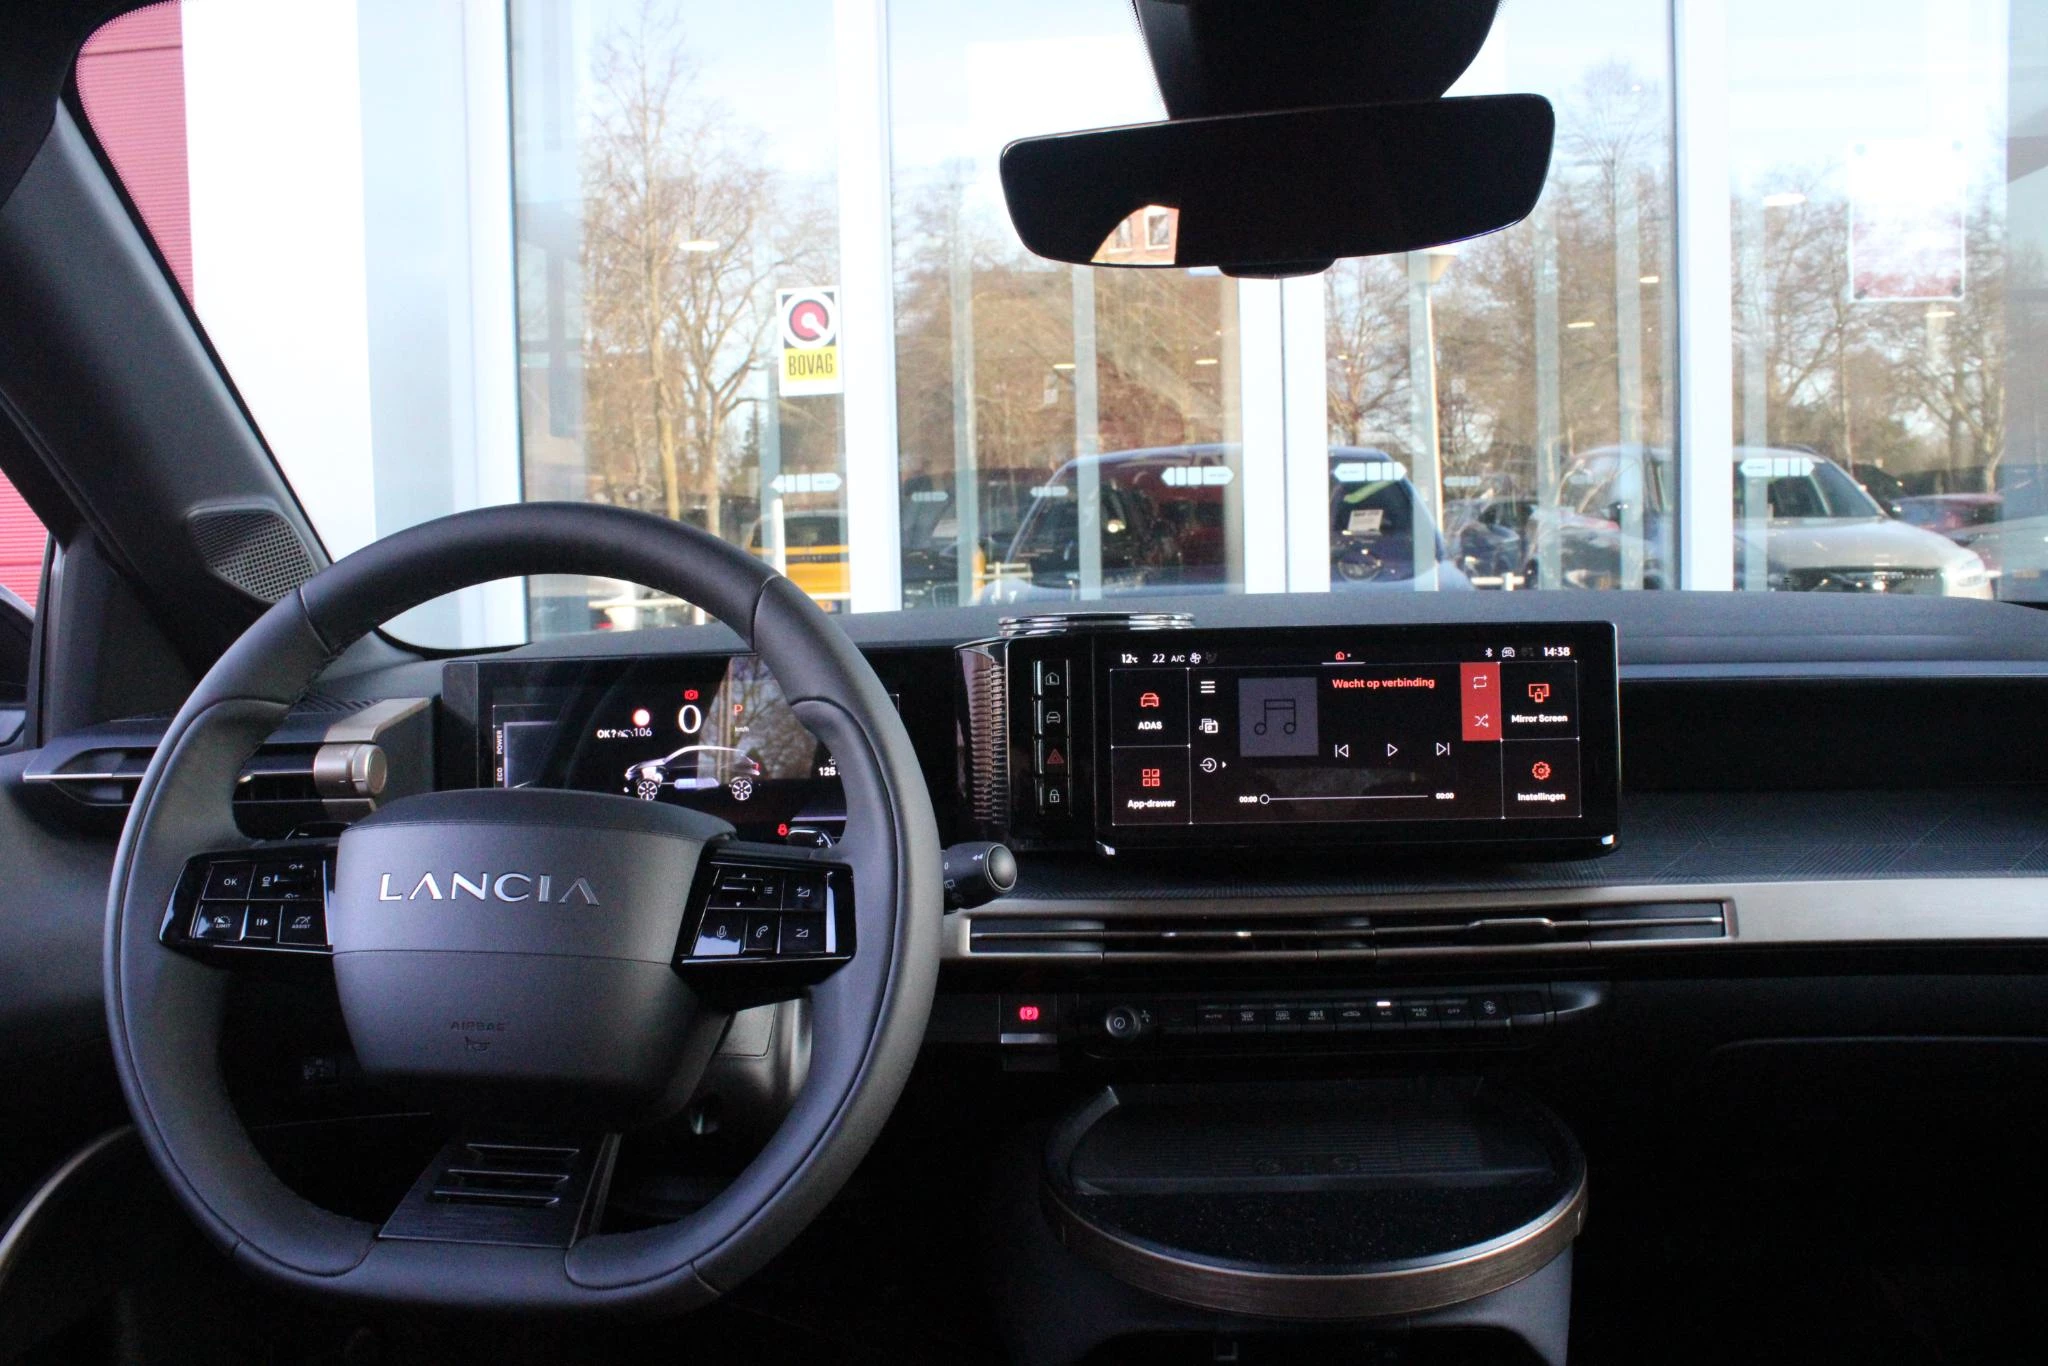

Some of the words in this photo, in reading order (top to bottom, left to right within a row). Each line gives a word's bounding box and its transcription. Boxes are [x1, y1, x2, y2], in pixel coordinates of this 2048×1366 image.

[788, 353, 833, 376] BOVAG
[1543, 646, 1570, 657] 14:38
[1152, 653, 1165, 664] 22
[1170, 654, 1186, 663] A/C
[1332, 678, 1365, 689] Wacht
[1366, 680, 1380, 690] op
[1381, 677, 1435, 689] verbinding
[734, 703, 744, 716] P
[678, 704, 702, 734] 0
[1511, 714, 1538, 723] Mirror
[1538, 713, 1568, 723] Screen
[1137, 721, 1163, 731] ADAS
[633, 727, 653, 737] 106
[818, 765, 836, 777] 125
[1517, 792, 1566, 803] Instellingen
[1127, 799, 1176, 810] App-drawer
[223, 878, 238, 887] OK
[378, 871, 601, 906] LANCIA
